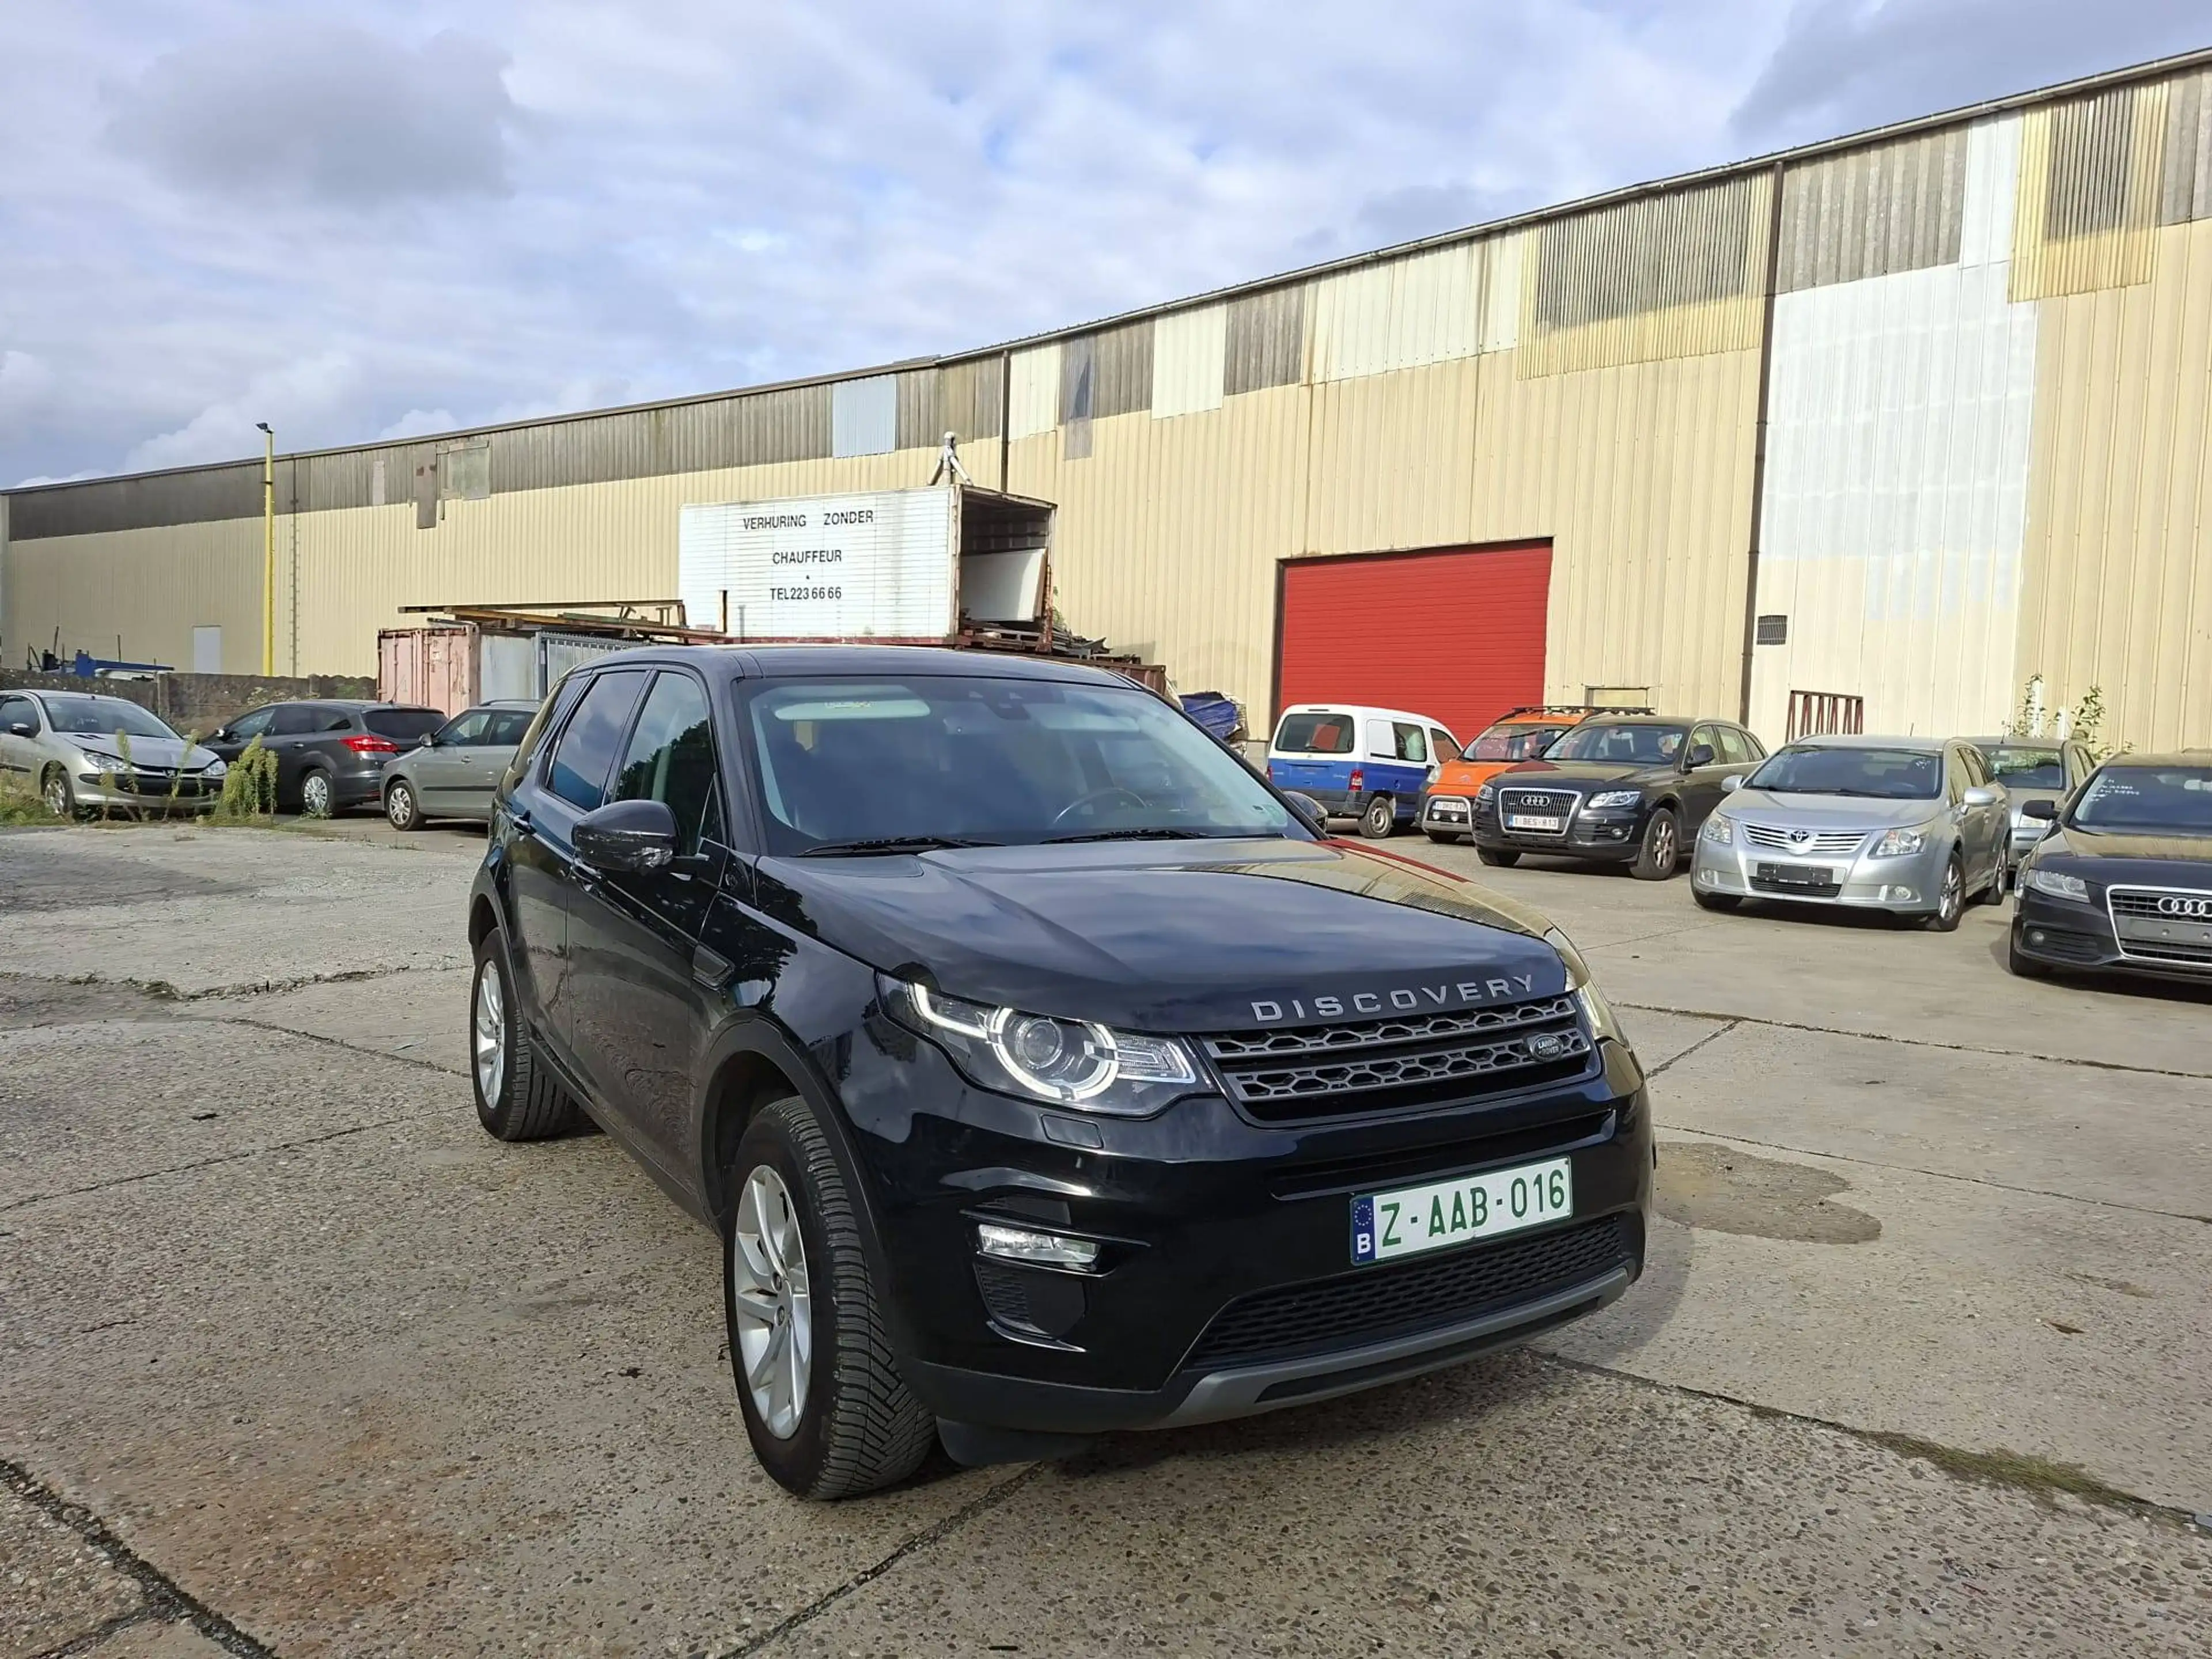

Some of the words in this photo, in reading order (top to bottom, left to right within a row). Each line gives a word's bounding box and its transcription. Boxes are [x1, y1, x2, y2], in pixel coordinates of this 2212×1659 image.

[743, 514, 806, 529] VERHURING
[823, 510, 874, 525] ZONDER
[772, 550, 842, 565] CHAUFFEUR
[1251, 974, 1532, 1022] DISCOVERY
[1380, 1169, 1565, 1248] Z-AAB-016
[1357, 1233, 1372, 1255] B
